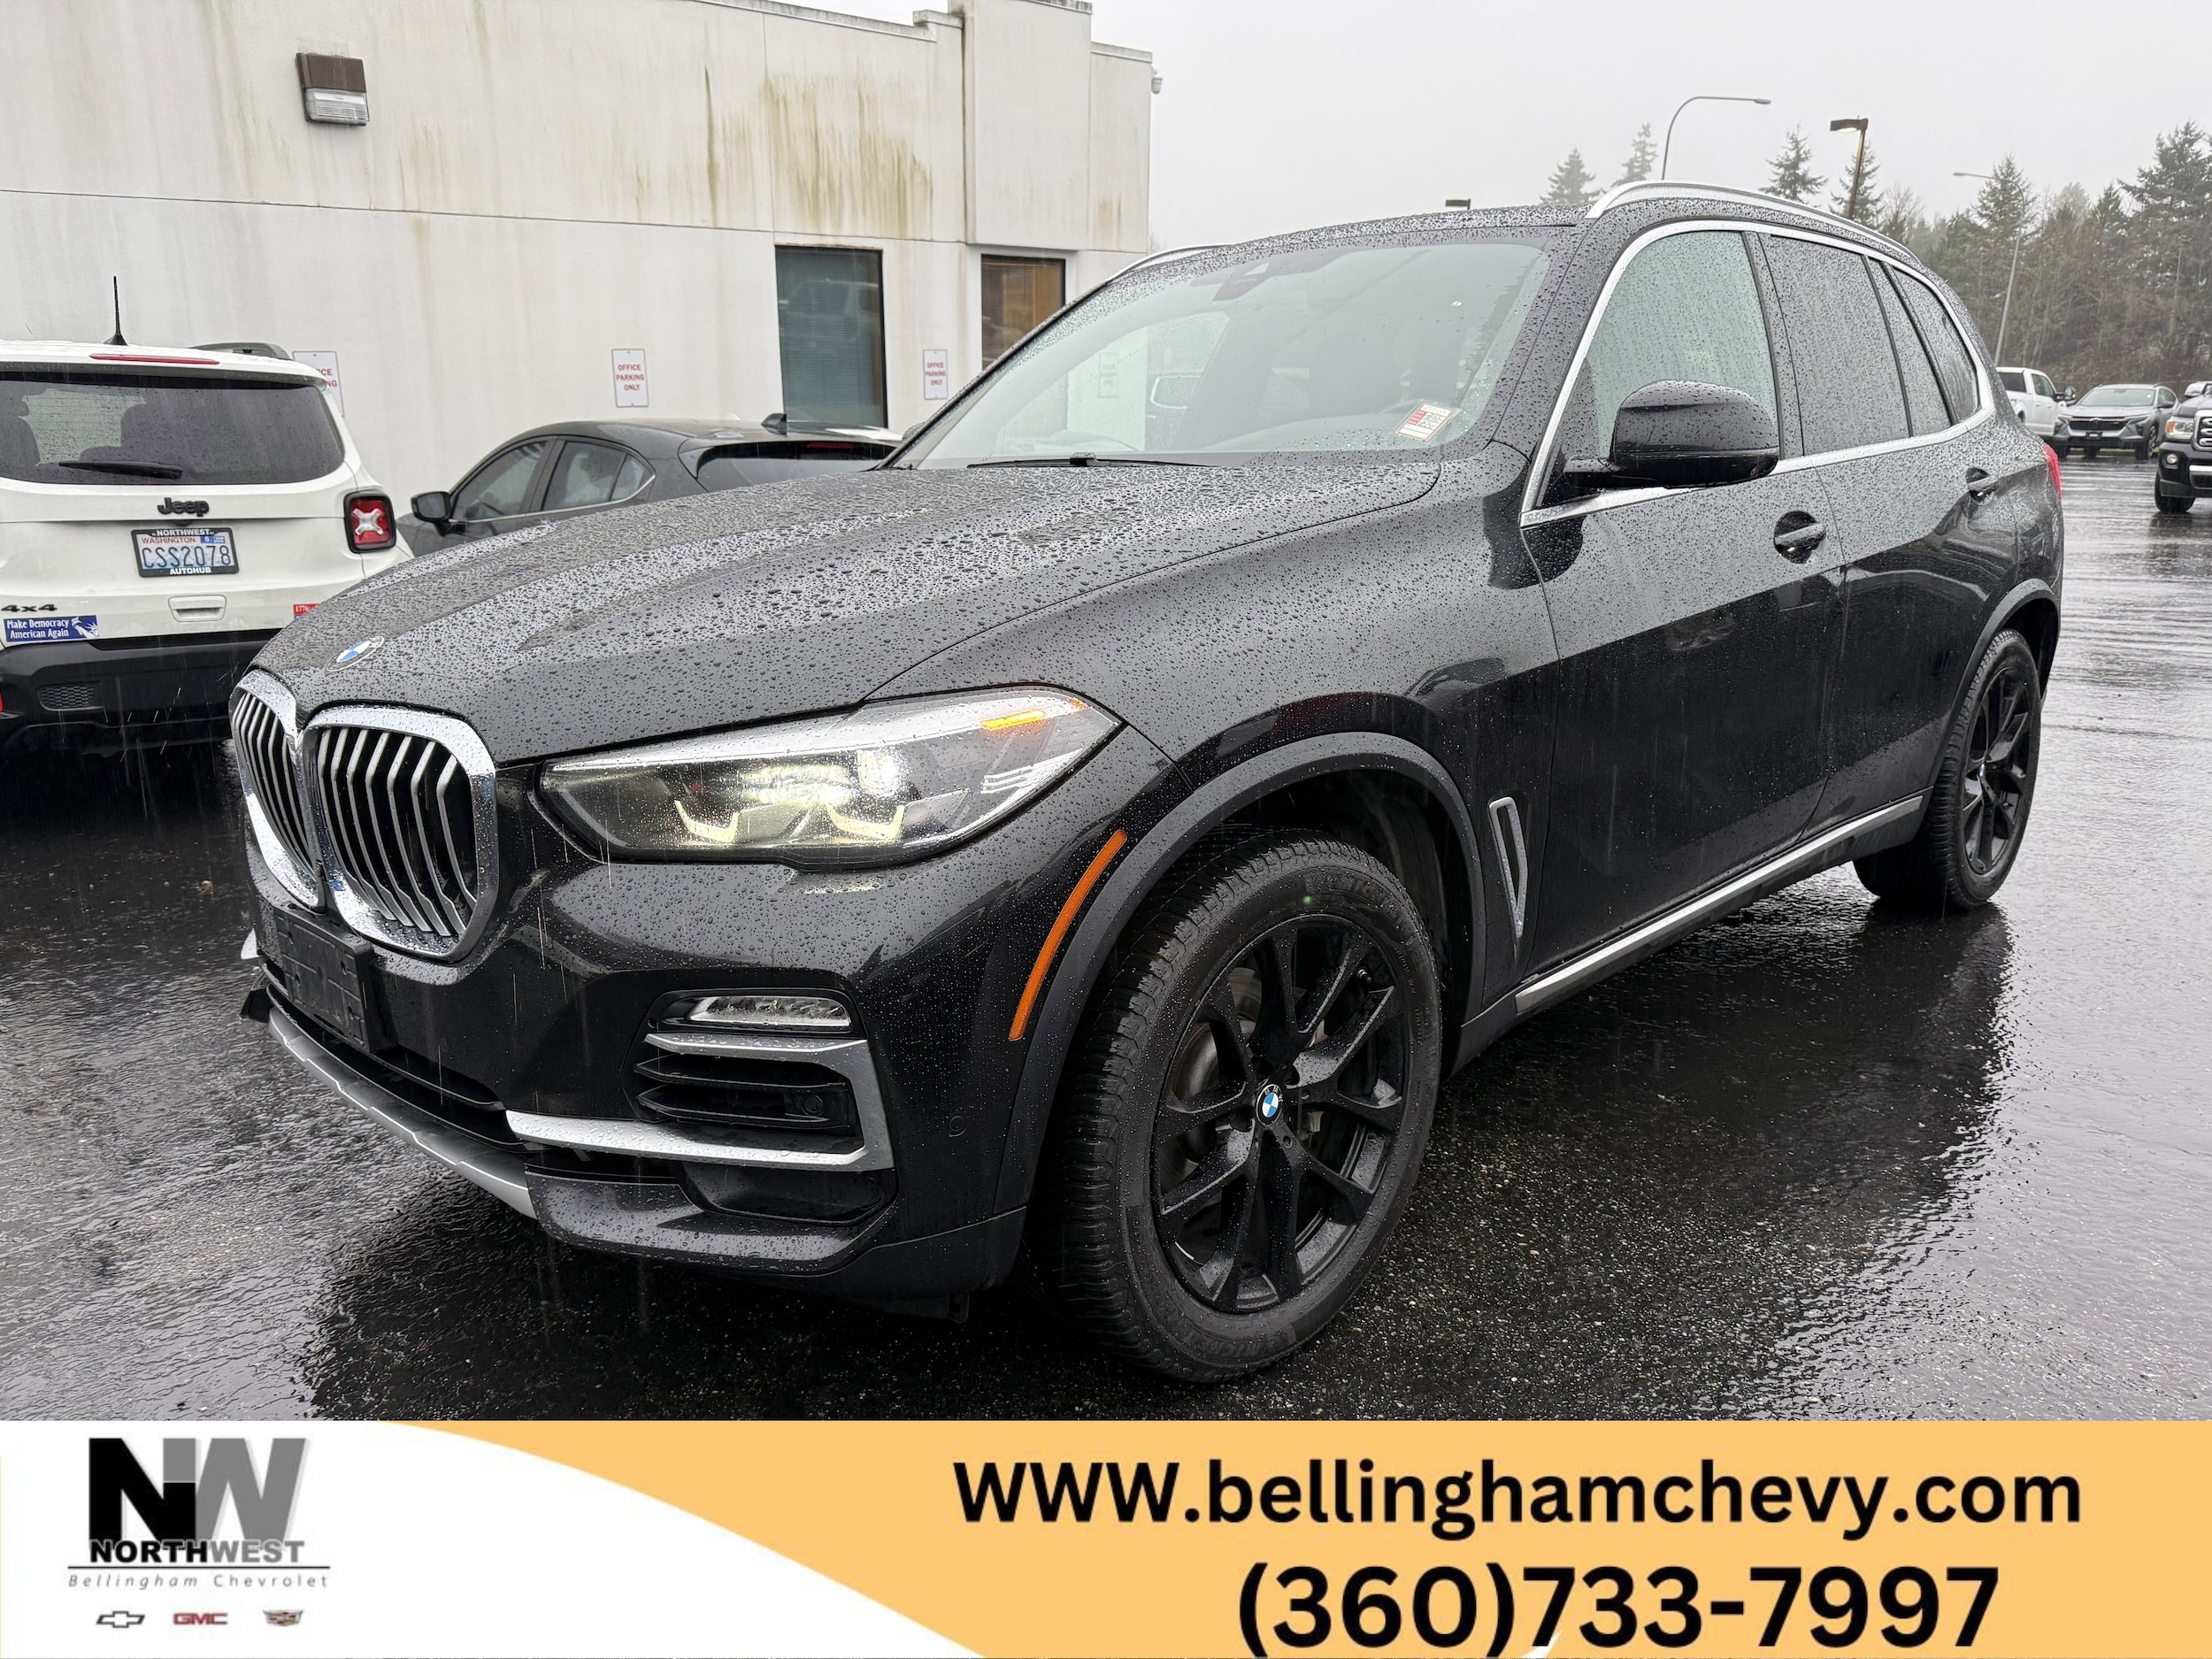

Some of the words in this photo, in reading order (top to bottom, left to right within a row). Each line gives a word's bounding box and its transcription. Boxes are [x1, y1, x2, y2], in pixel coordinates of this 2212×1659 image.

[157, 497, 210, 518] Jeep
[142, 535, 196, 544] WASHINGTON
[142, 545, 231, 568] CSS2078
[170, 566, 211, 575] AUTOHUB
[1, 603, 58, 612] 4x4
[6, 619, 27, 629] Make
[29, 619, 69, 628] Democracy
[10, 630, 46, 639] American
[48, 628, 69, 639] Again
